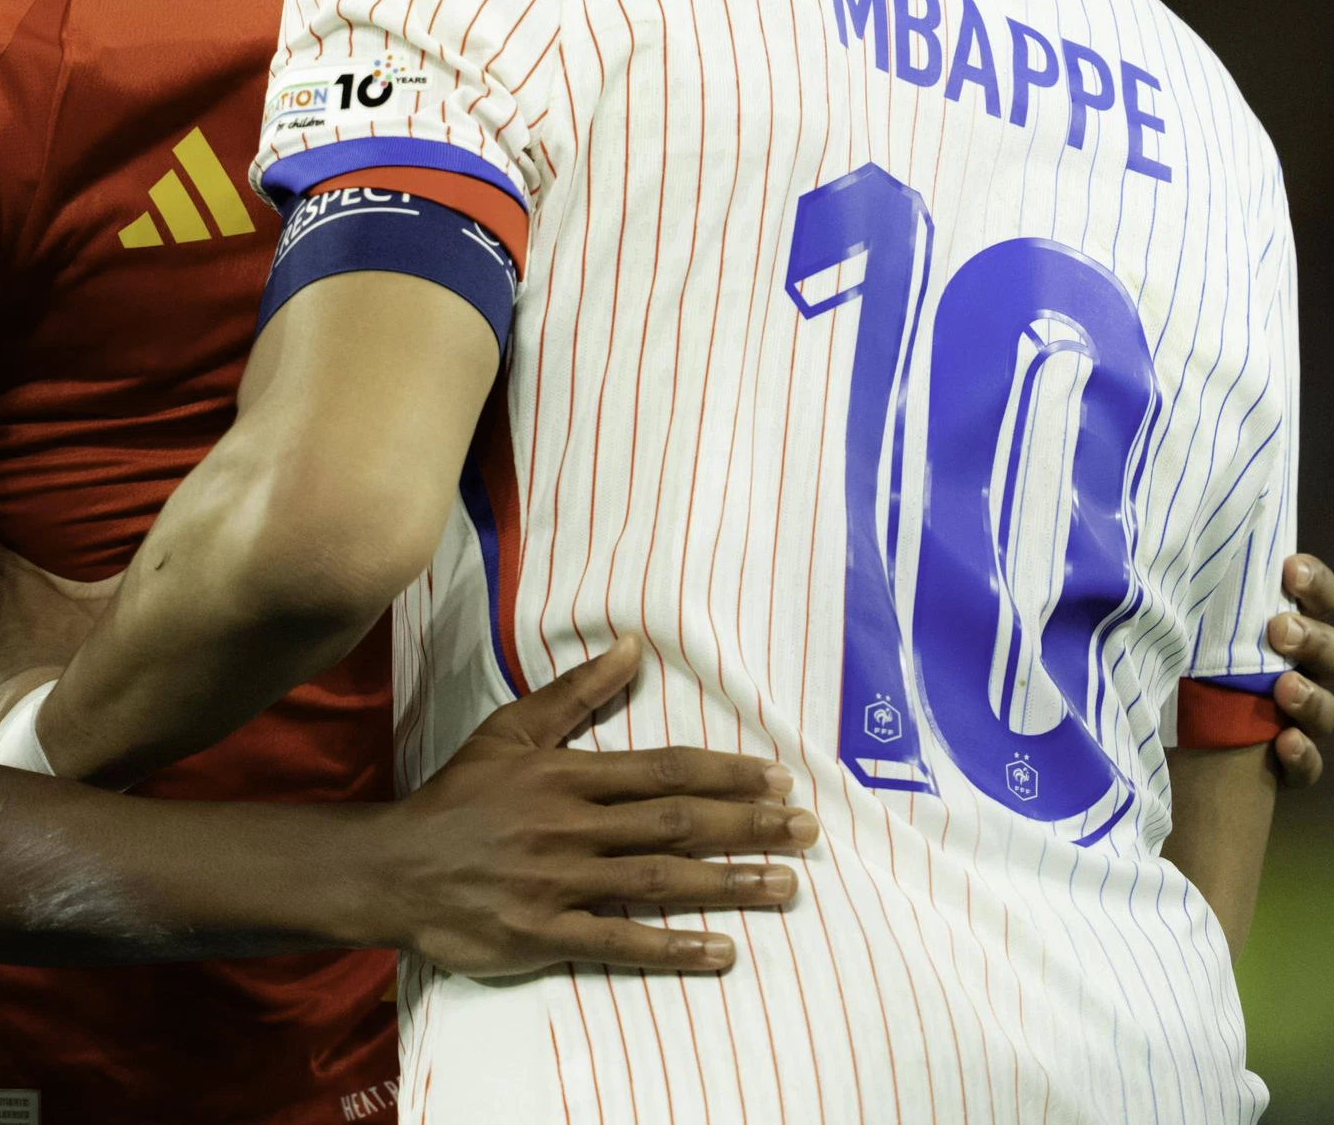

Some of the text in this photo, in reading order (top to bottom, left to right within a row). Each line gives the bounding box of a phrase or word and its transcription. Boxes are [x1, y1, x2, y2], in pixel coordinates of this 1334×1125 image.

[334, 73, 393, 110] 10
[396, 76, 427, 84] YEARS
[785, 162, 1161, 847] 10
